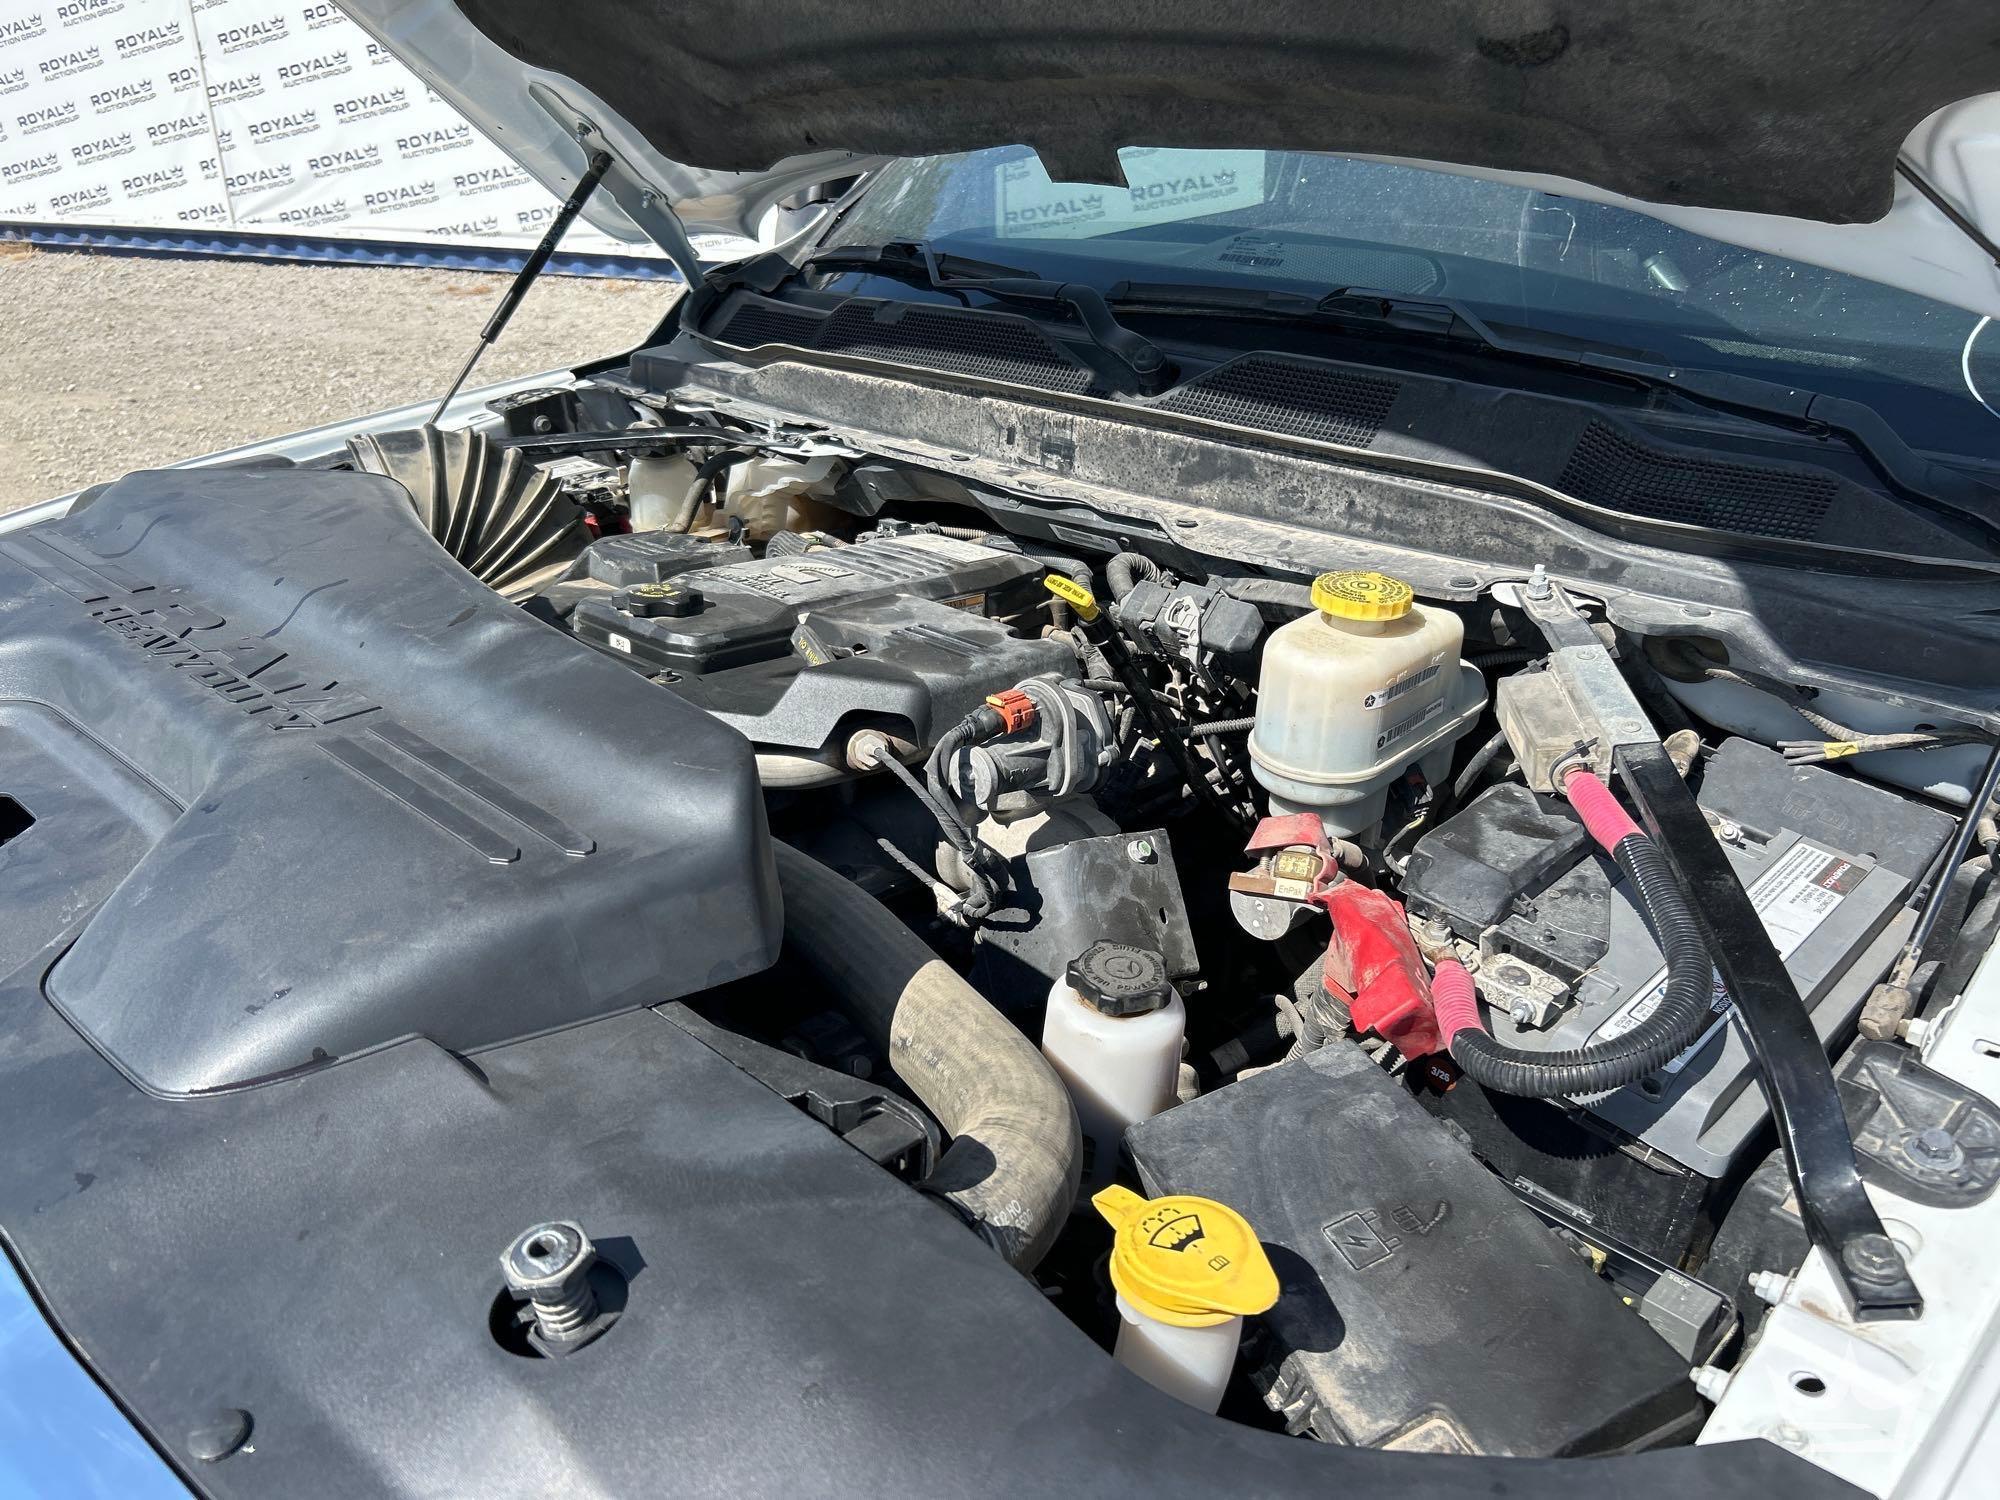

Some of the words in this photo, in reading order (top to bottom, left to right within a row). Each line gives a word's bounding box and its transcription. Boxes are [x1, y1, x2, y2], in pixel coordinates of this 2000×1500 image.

[303, 3, 338, 21] ROY
[0, 19, 31, 38] YAL
[115, 26, 167, 50] ROYAL
[218, 21, 272, 46] ROYAL
[38, 50, 88, 73] ROYAL
[278, 55, 334, 79] ROYAL
[168, 67, 199, 84] ROY
[90, 84, 141, 106] ROYAL
[207, 78, 248, 98] OYAL
[209, 94, 236, 108] CTION
[334, 92, 391, 116] ROYAL
[17, 105, 65, 128] ROYAL
[147, 115, 199, 138] ROYAL
[249, 114, 302, 137] ROYAL
[188, 126, 209, 139] GROU
[396, 127, 455, 150] ROYAL
[72, 137, 120, 158] ROYAL
[1, 156, 47, 178] ROYAL
[308, 148, 365, 171] ROYAL
[122, 169, 172, 191] ROYAL
[225, 167, 279, 189] ROYAL
[454, 164, 514, 188] ROYAL
[1129, 172, 1214, 201] ROYAL
[50, 188, 97, 209] ROYAL
[364, 185, 422, 206] ROYAL
[278, 203, 333, 223] ROYAL
[1003, 200, 1083, 225] ROYAL
[92, 606, 214, 669] HEAVY
[188, 669, 317, 731] DUTY
[112, 603, 383, 725] RAM
[1431, 1066, 1450, 1082] 3/26
